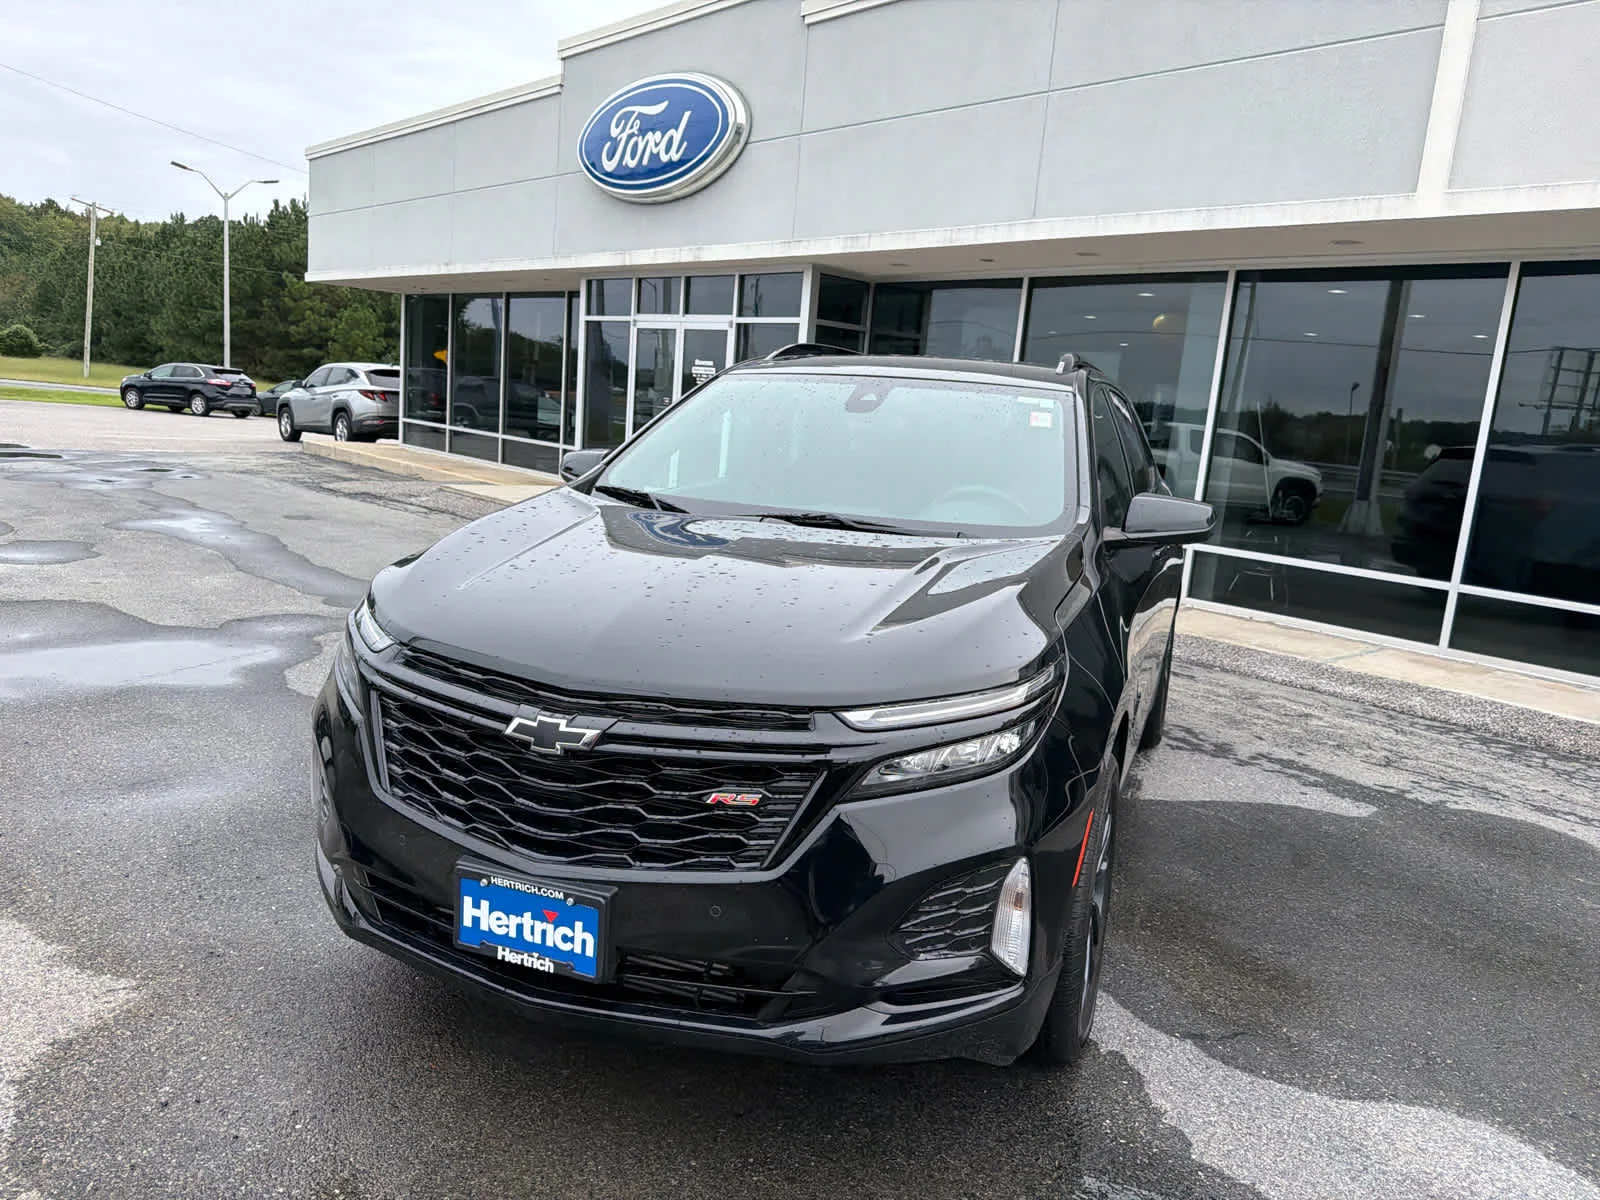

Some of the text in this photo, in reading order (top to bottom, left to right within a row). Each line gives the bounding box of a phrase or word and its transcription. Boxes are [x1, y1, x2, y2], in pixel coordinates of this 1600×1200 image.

[602, 100, 692, 172] Ford
[705, 793, 762, 806] RS
[490, 876, 564, 900] HERTRICH.COM
[463, 896, 595, 958] Hertrich
[497, 946, 554, 973] Hertrich
